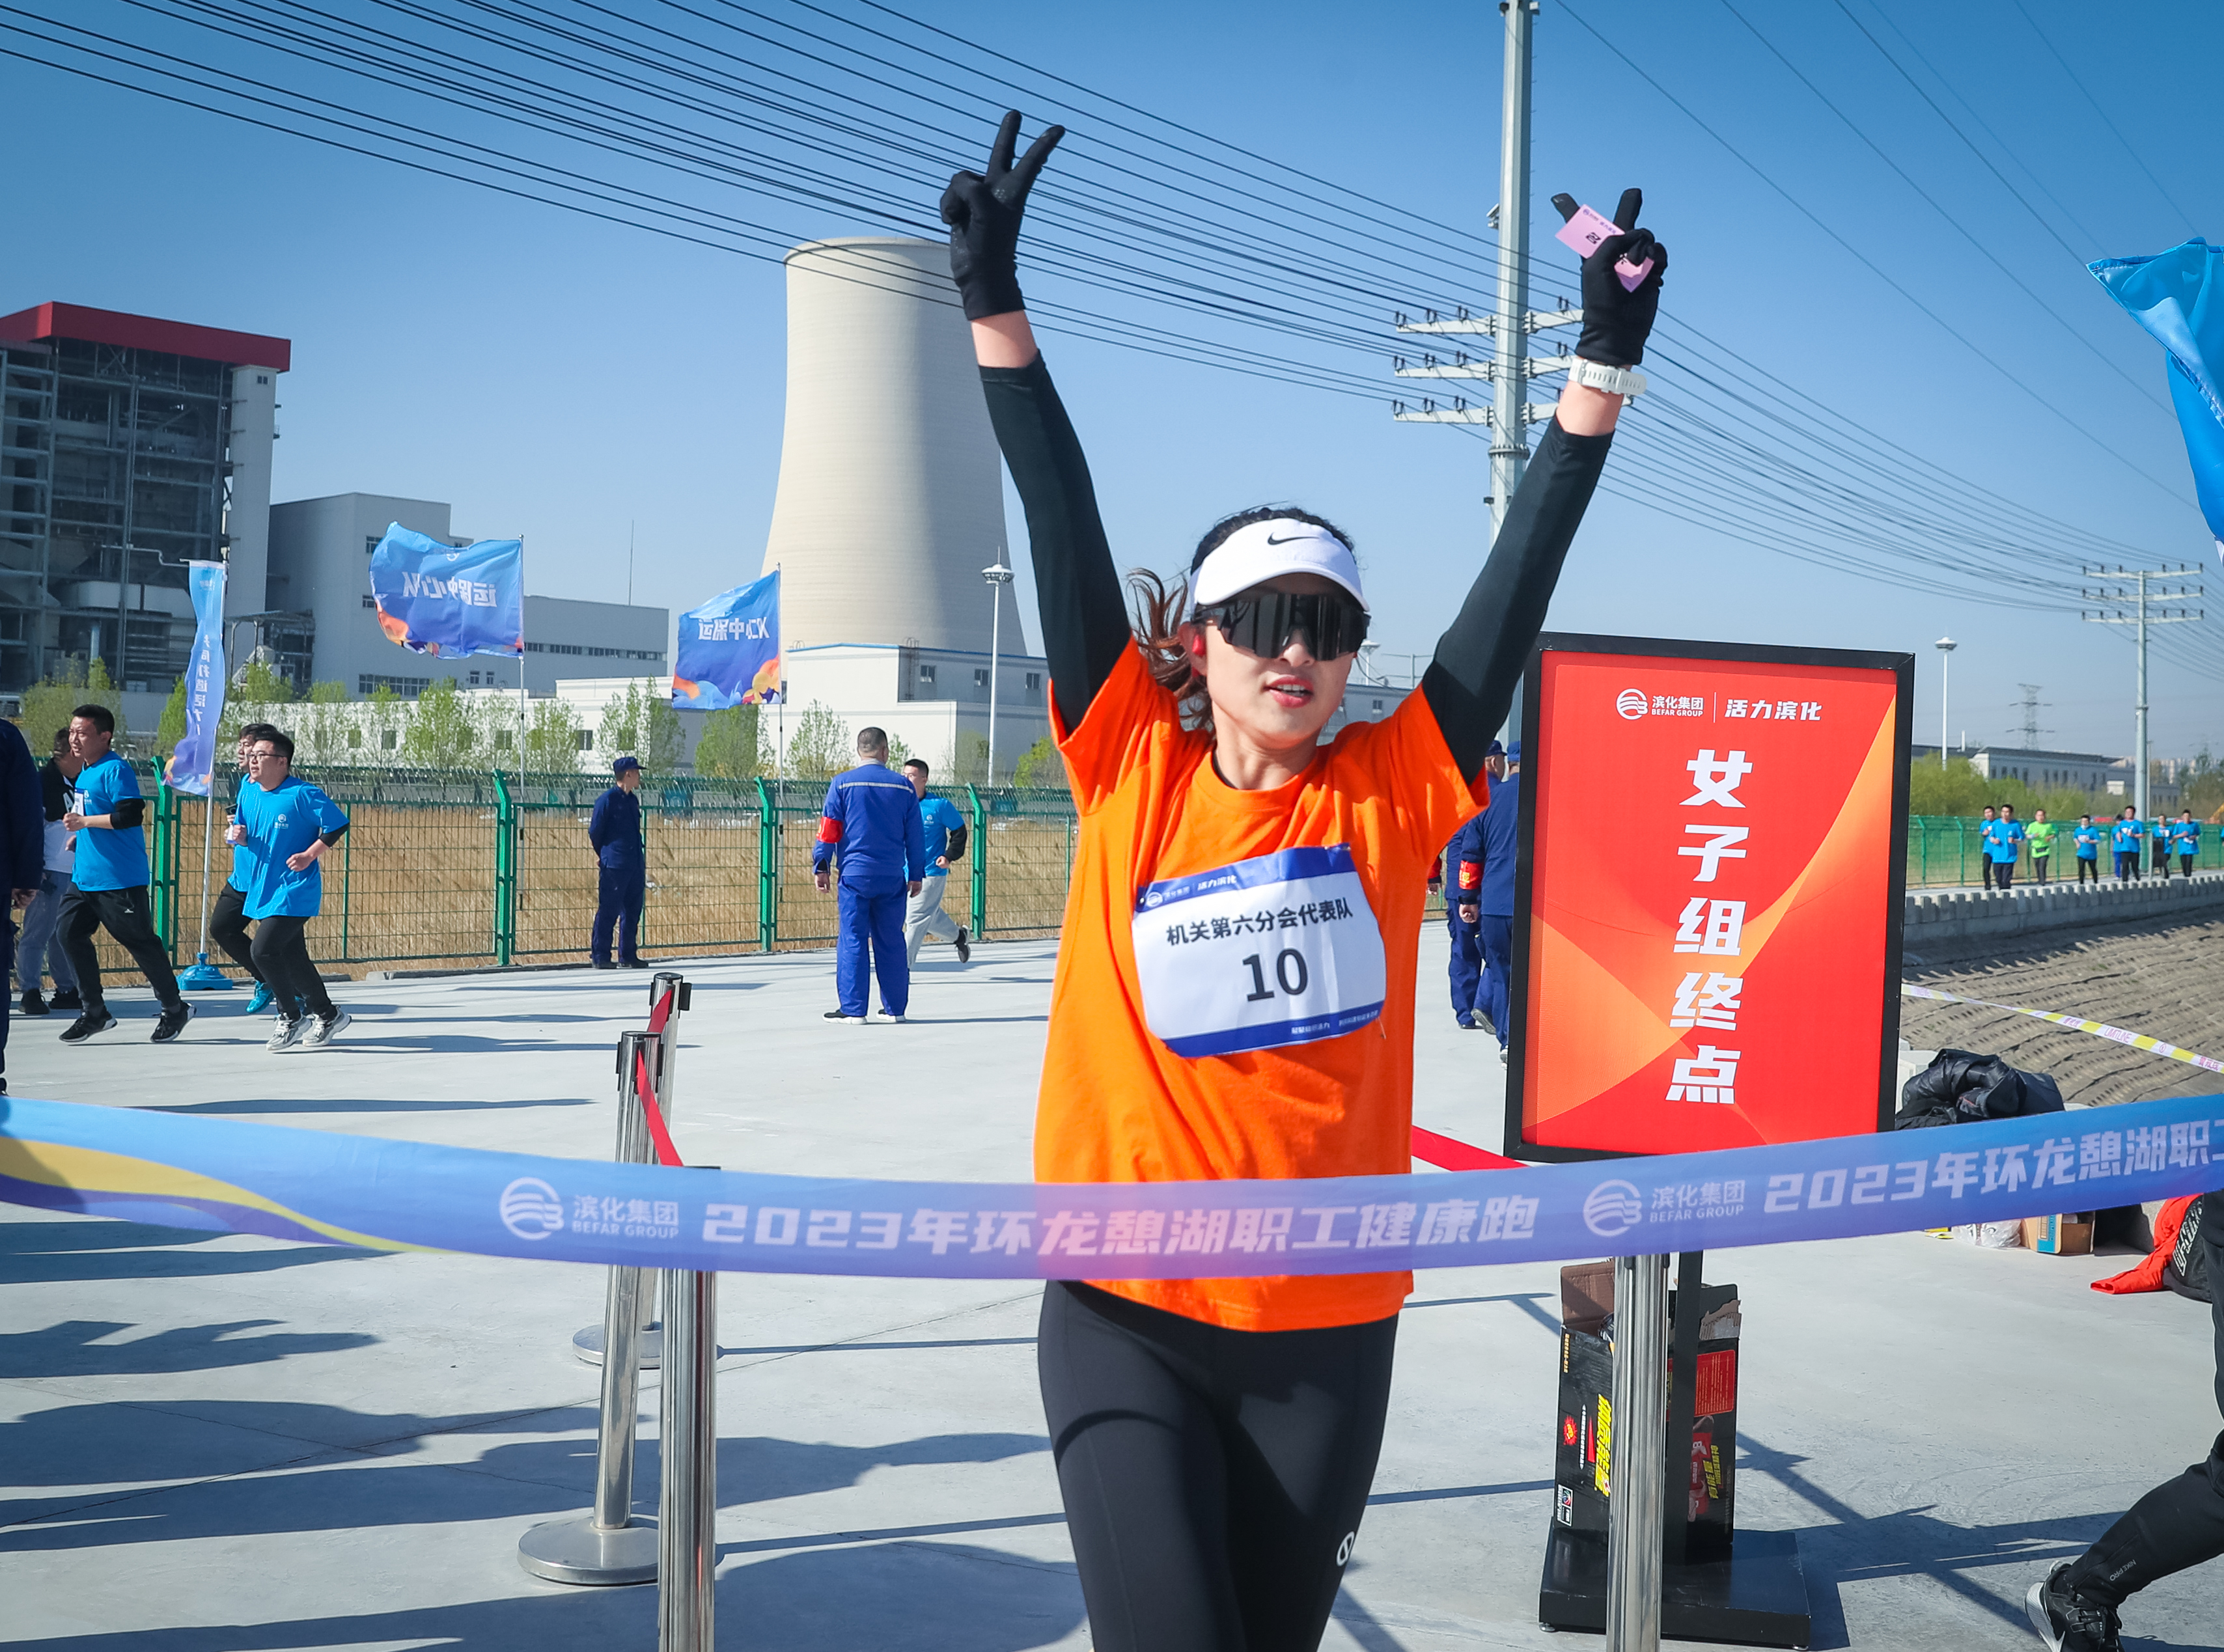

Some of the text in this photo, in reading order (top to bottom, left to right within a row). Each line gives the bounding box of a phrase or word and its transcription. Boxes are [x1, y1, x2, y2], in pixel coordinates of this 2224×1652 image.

[1652, 695, 1704, 710] 滨化集团
[1725, 698, 1822, 721] 活力滨化
[1166, 898, 1354, 946] 机关第六分会代表队
[1665, 749, 1754, 1105] 女子组终点
[1242, 948, 1309, 1002] 10
[1651, 1179, 1746, 1209] 滨化集团
[573, 1194, 678, 1225] 滨化集团
[1649, 1205, 1745, 1223] BEFAR GROUP
[572, 1220, 679, 1239] BEFAR GROUP
[702, 1194, 1540, 1256] 2023年环龙憩湖职工健康跑
[2109, 1559, 2136, 1581] NIKE PRO
